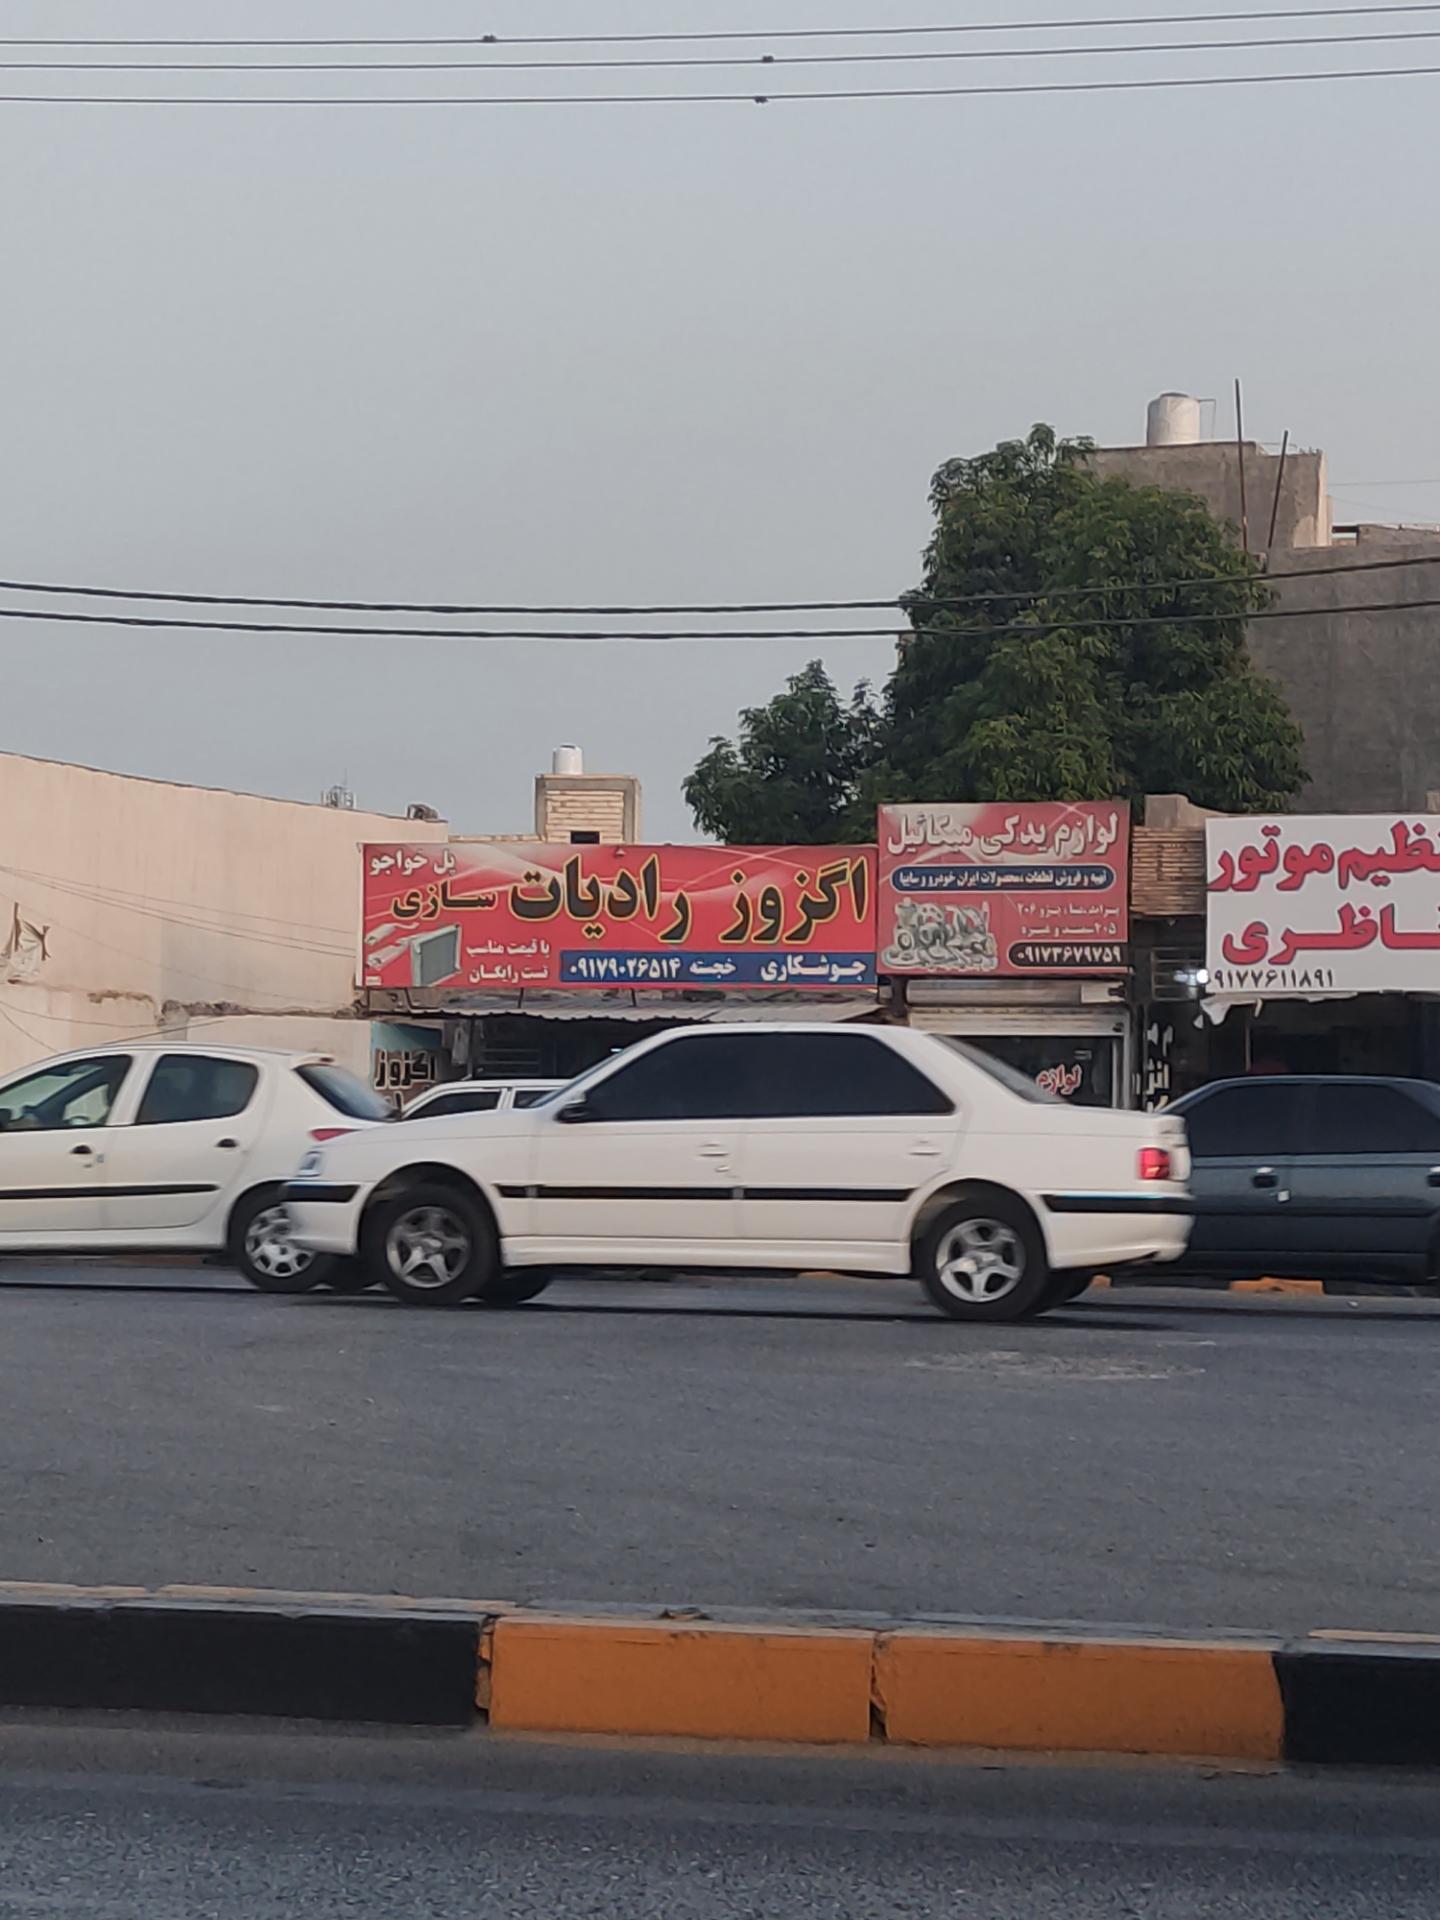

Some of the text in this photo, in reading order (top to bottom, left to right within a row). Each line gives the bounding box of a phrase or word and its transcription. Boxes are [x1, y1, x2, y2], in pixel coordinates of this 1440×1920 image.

[887, 812, 1118, 856] لوازم یدکی میکائیل
[369, 847, 457, 876] پل خواجو
[1207, 825, 1335, 891] موتور
[392, 880, 498, 919] سازی
[718, 855, 868, 944] اگزوز
[760, 953, 867, 982] جوشکاری
[1208, 969, 1333, 988] ۹۱۷۷۶۱۱۸۹۱
